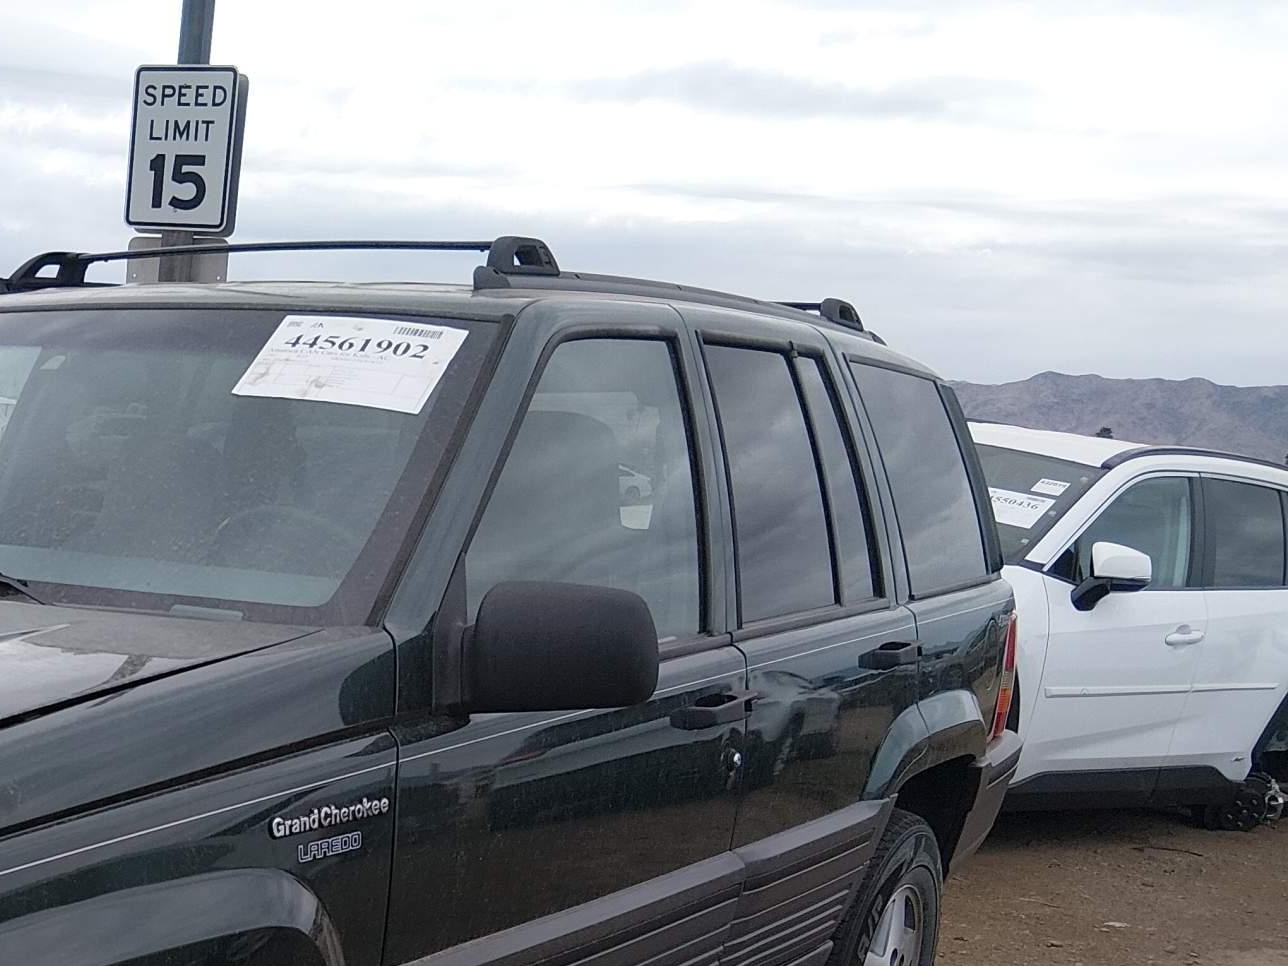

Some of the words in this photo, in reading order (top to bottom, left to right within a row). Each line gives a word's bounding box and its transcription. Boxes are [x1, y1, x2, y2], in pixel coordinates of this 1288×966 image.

[143, 84, 228, 107] SPEED
[149, 119, 215, 142] LIMIT
[149, 153, 207, 210] 15
[284, 333, 430, 360] 44561902
[272, 808, 319, 838] Grand
[320, 797, 390, 827] Cherokee
[298, 831, 362, 863] LAREDO
